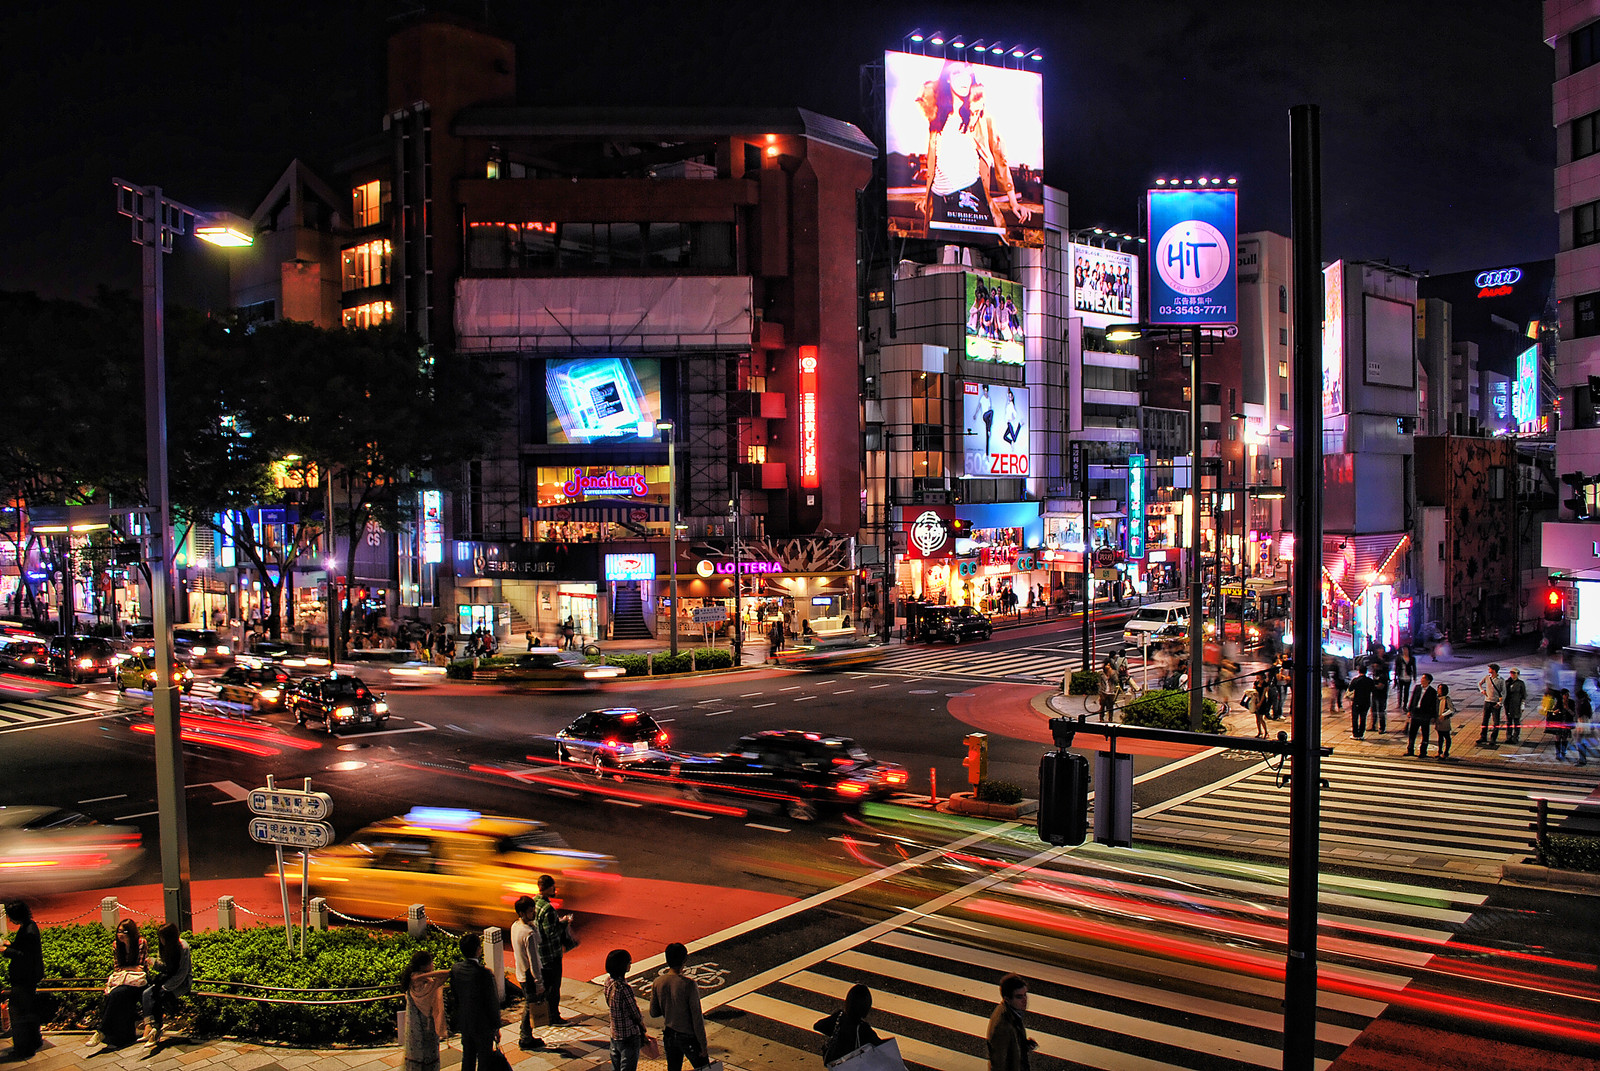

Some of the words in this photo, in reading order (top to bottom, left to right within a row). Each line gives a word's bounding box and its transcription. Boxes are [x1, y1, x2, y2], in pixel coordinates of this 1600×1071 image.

[947, 211, 989, 220] BURBERRY
[1477, 285, 1512, 298] Audi
[1174, 297, 1212, 305] 広告募集中
[1159, 305, 1227, 315] 03-3543-7771
[990, 453, 1028, 474] ZERO
[270, 823, 306, 836] 明治神宮
